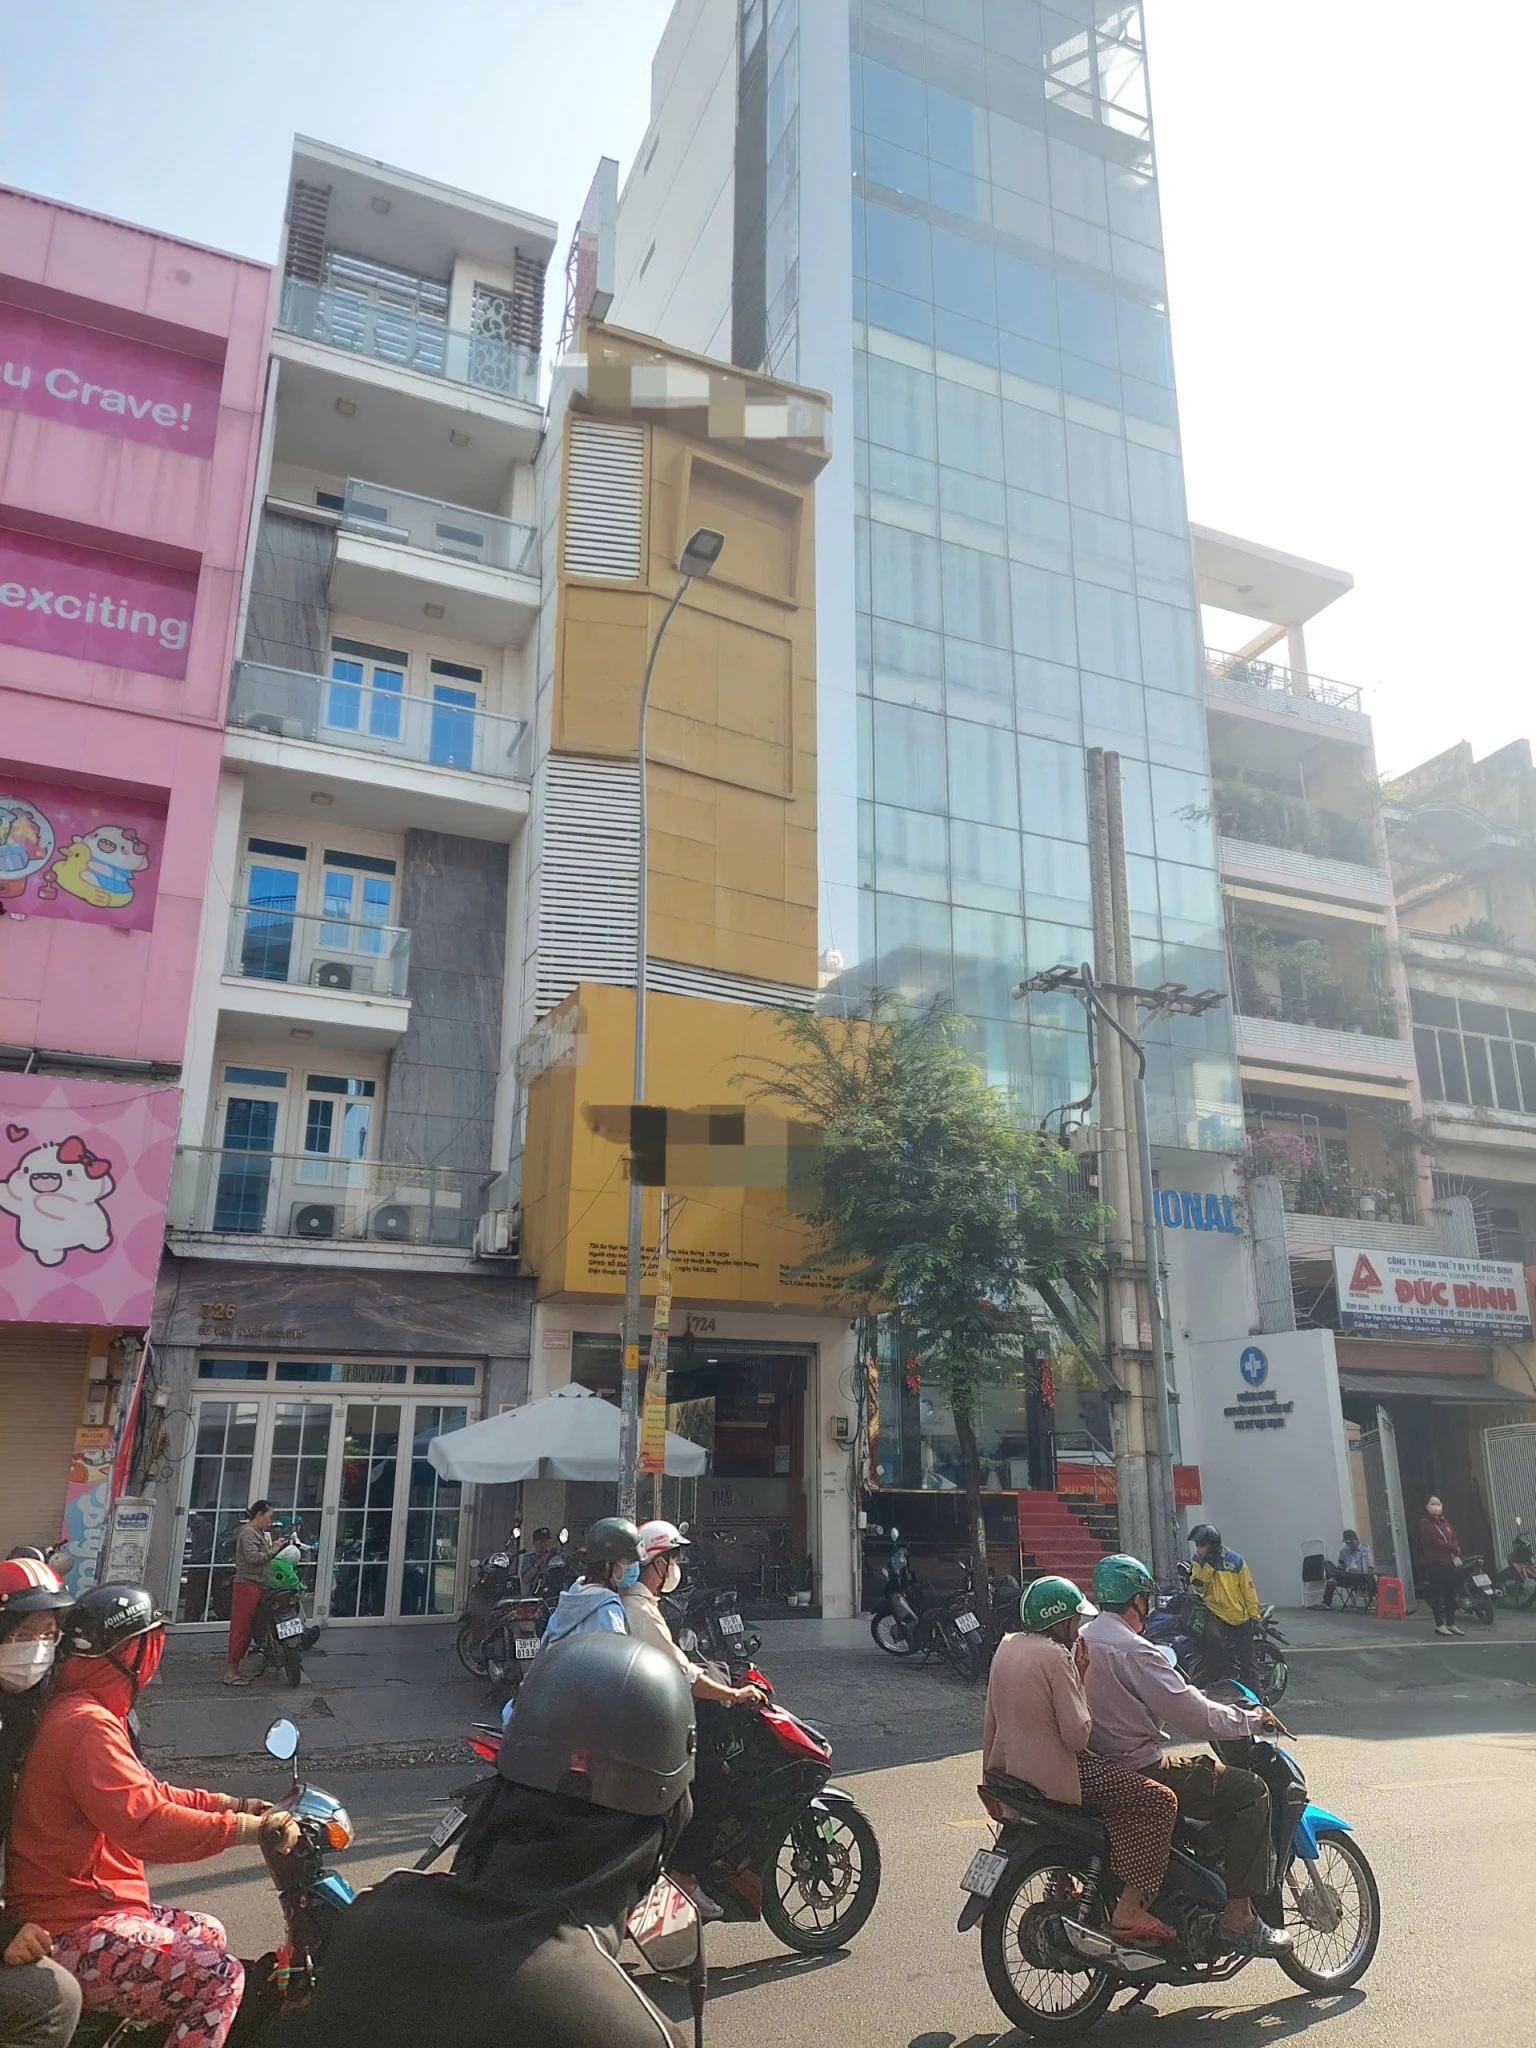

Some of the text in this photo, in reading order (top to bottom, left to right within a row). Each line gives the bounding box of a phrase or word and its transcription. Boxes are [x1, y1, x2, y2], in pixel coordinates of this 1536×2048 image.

[45, 368, 192, 431] Crave!
[0, 582, 187, 650] exciting
[1387, 1256, 1406, 1266] CÔNG
[1409, 1259, 1416, 1267] TY
[1419, 1259, 1437, 1269] TNHH
[1450, 1272, 1486, 1281] EQUIPMENT
[1395, 1277, 1517, 1312] ĐỨC BÌNH
[202, 1302, 237, 1319] 726
[692, 1316, 716, 1331] 724
[1040, 1600, 1067, 1619] Grab
[104, 1611, 125, 1629] JOHN
